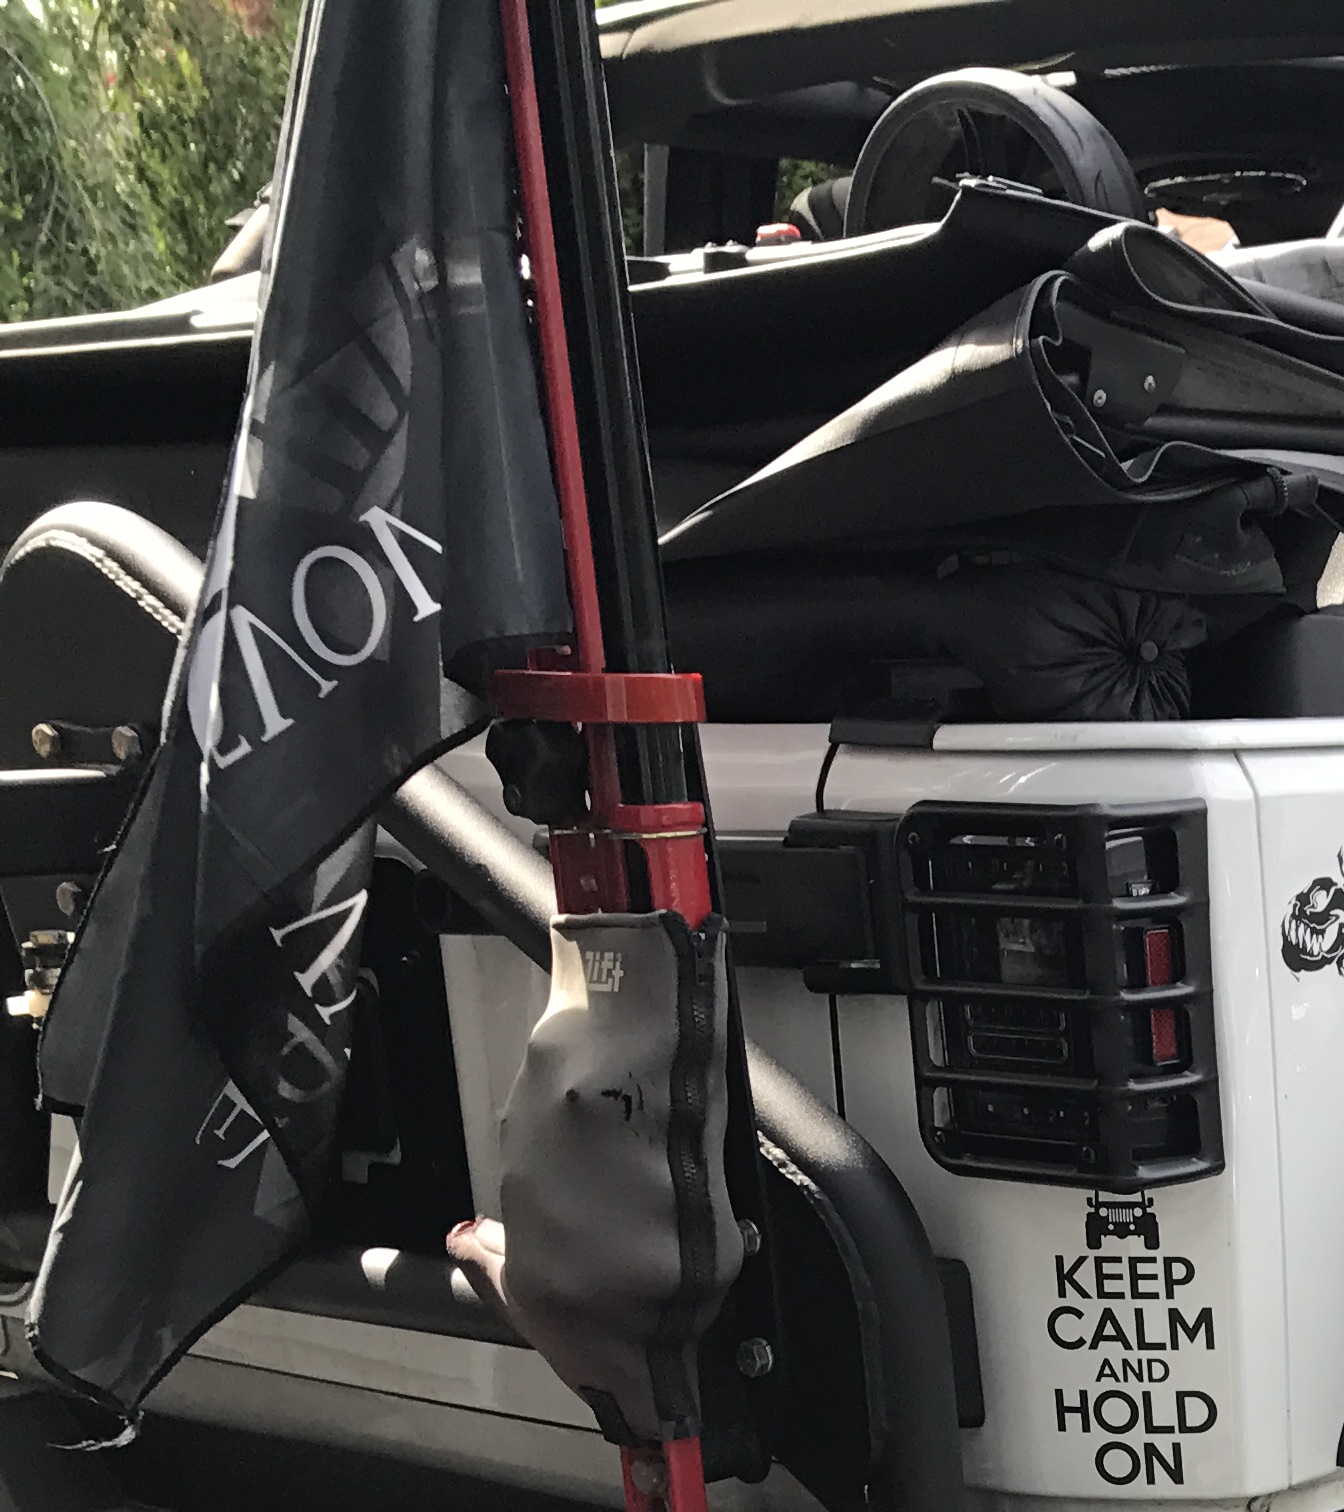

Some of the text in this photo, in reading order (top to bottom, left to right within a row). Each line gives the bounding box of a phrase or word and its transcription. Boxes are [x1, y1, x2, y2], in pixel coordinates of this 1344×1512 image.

[1054, 1254, 1196, 1300] KEEP
[1046, 1306, 1216, 1351] CALM
[1095, 1357, 1171, 1384] AND
[1054, 1388, 1218, 1435] HOLD
[1094, 1441, 1185, 1486] ON
